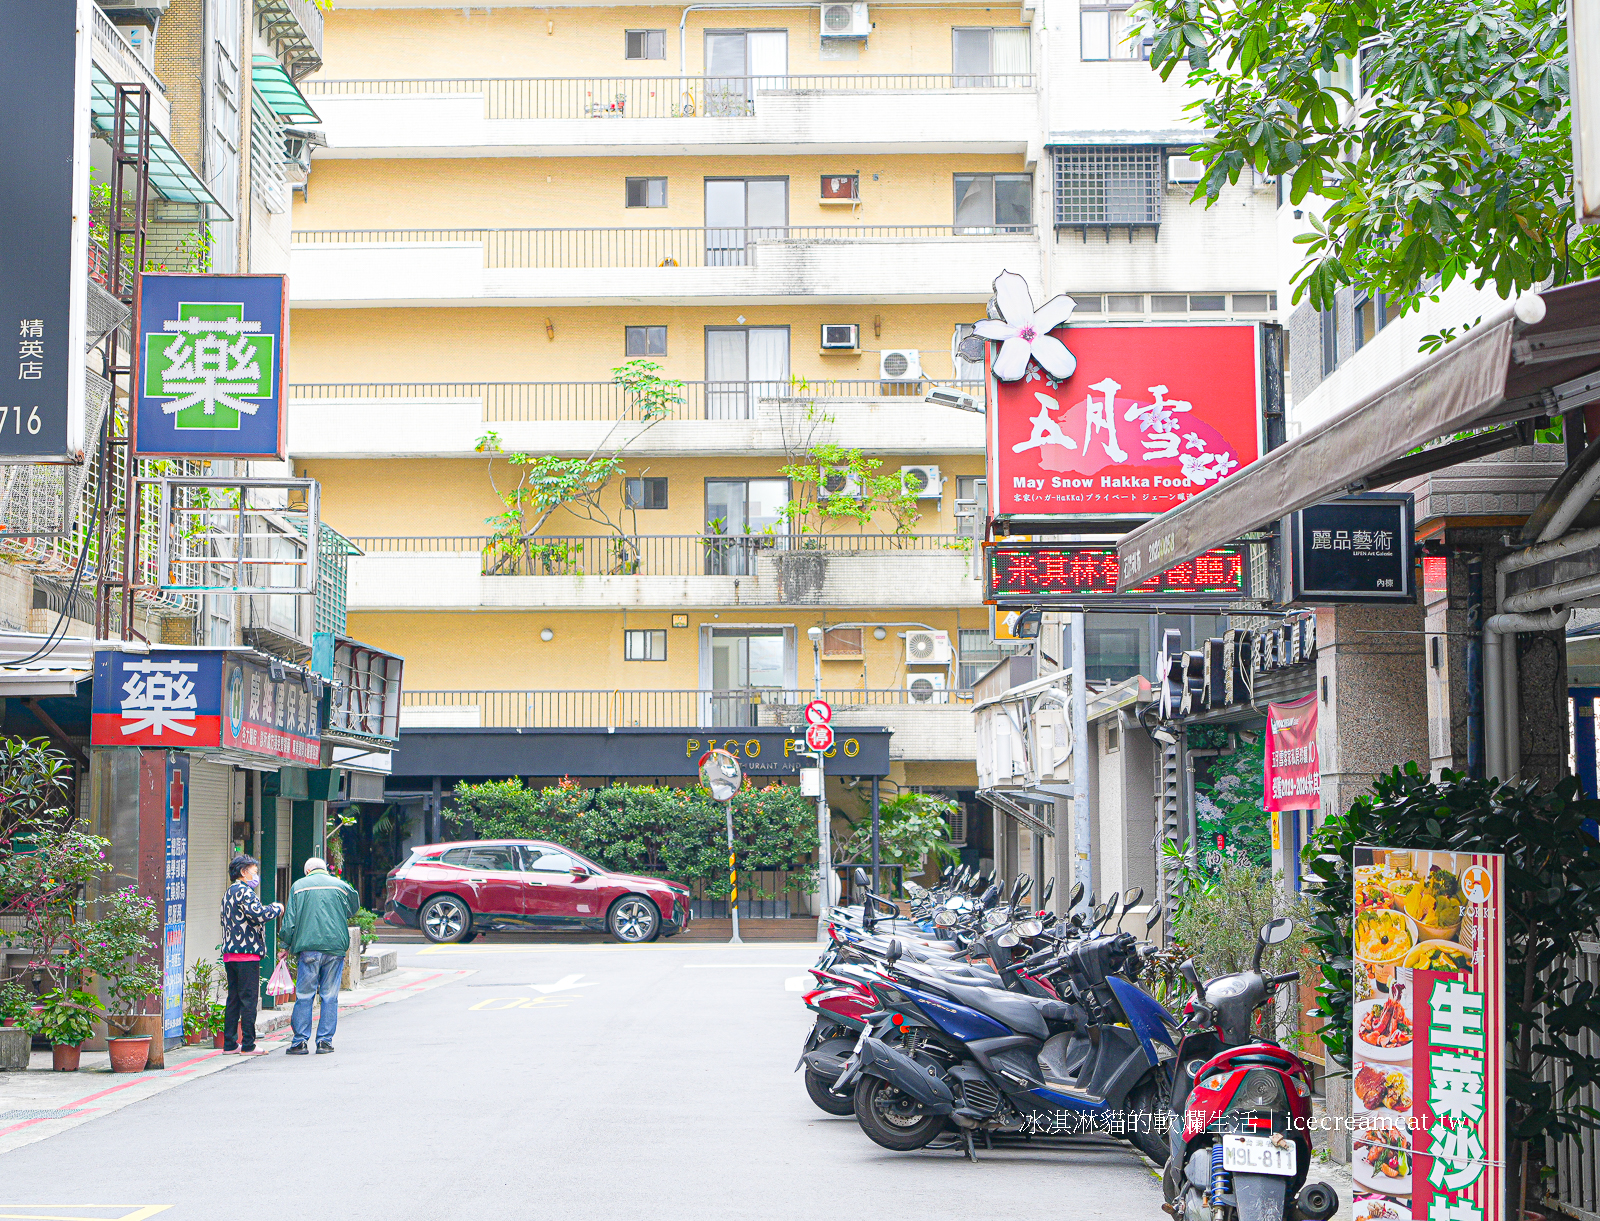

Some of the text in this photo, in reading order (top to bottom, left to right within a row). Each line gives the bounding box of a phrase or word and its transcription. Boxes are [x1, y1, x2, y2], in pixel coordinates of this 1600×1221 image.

[18, 318, 45, 380] 精英店
[160, 316, 262, 416] 藥
[1011, 377, 1193, 463] 五月雪
[1013, 475, 1192, 491] May Snow Hakka Food
[1311, 529, 1394, 550] 麗品藝術
[119, 659, 199, 737] 藥
[810, 728, 829, 746] 停
[1458, 905, 1497, 920] KOKKI
[1225, 1147, 1293, 1170] M9L-811
